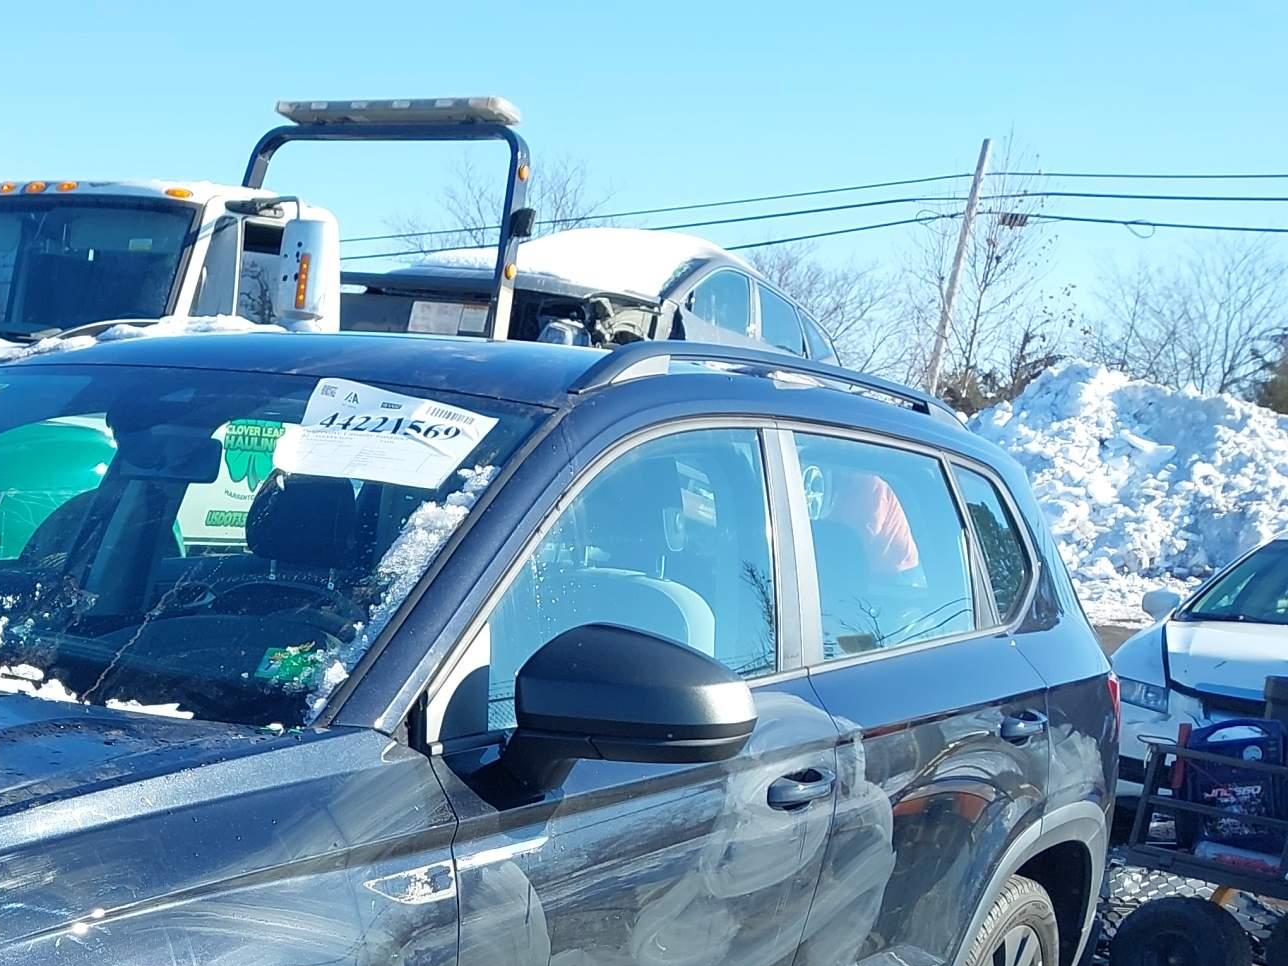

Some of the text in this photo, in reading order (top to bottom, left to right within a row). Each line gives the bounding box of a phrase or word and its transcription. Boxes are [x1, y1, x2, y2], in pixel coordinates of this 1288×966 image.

[226, 424, 261, 436] CLOVER
[319, 411, 461, 441] 44221569
[225, 436, 277, 452] HAULIN
